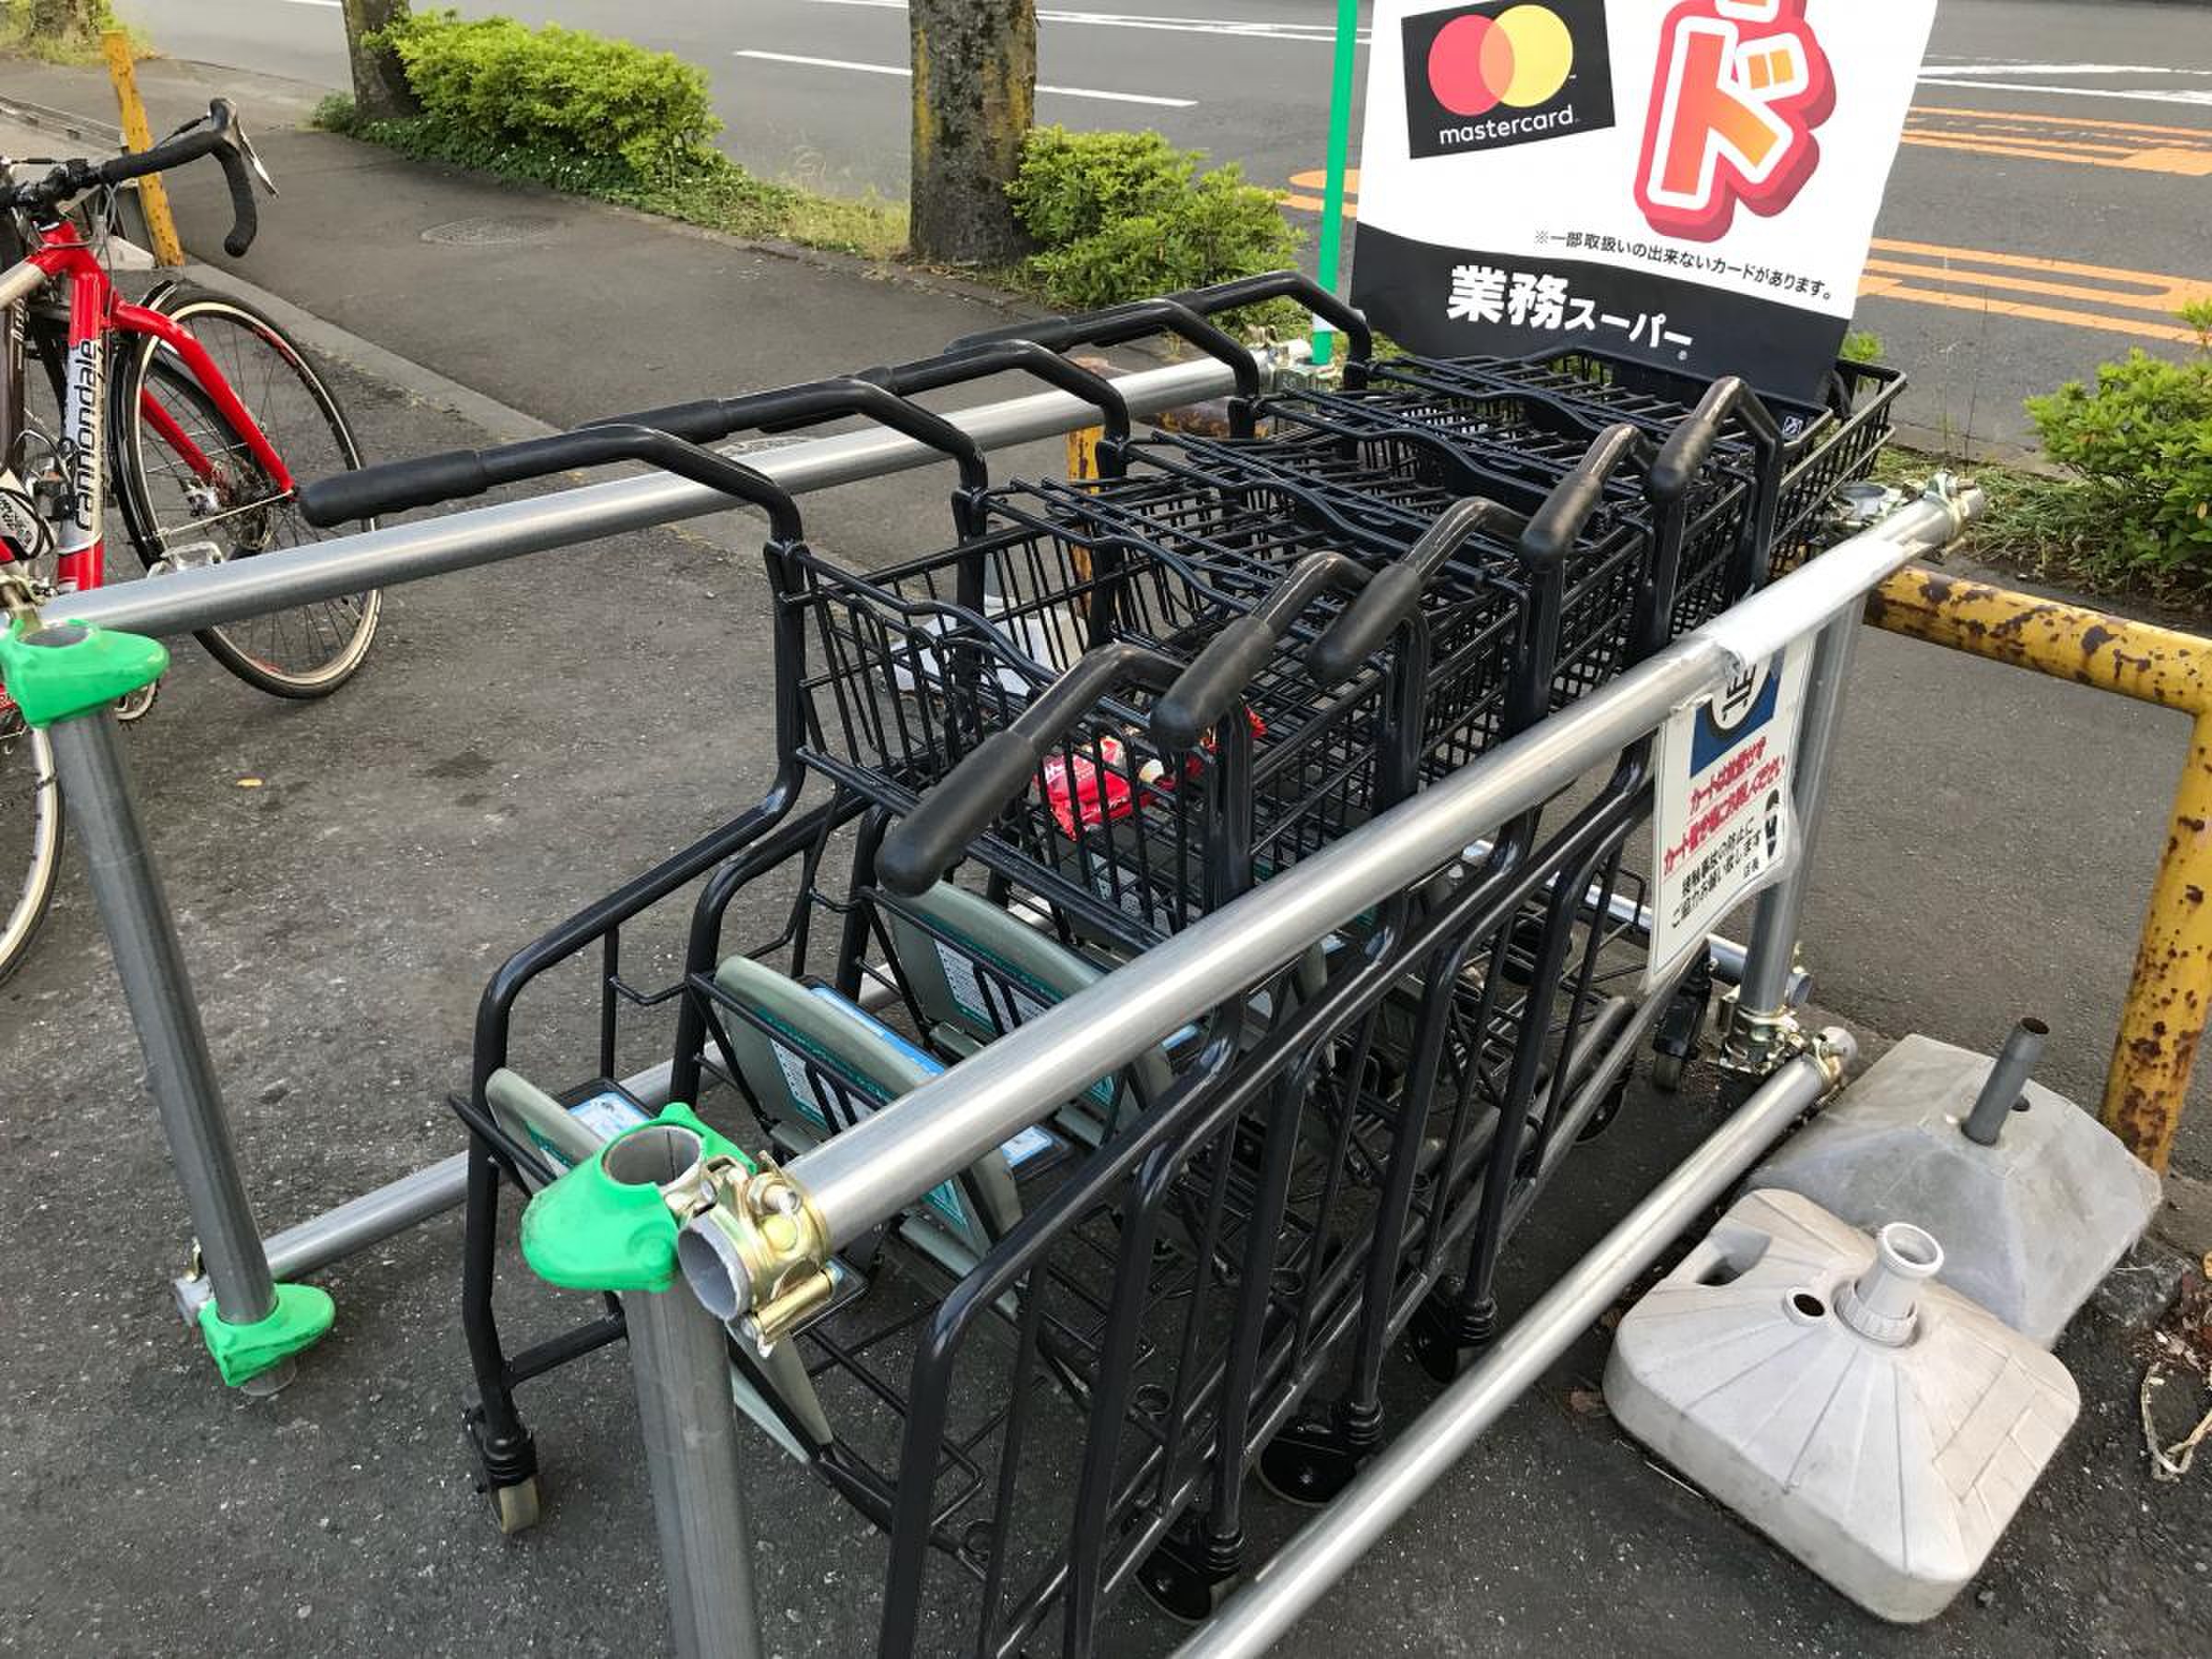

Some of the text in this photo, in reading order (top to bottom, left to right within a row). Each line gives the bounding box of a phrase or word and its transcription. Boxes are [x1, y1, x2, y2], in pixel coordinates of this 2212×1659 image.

[1440, 104, 1574, 146] mastercard
[1639, 0, 1831, 236] ド
[1446, 265, 1694, 347] 業務スーパー
[73, 339, 98, 531] cannondale
